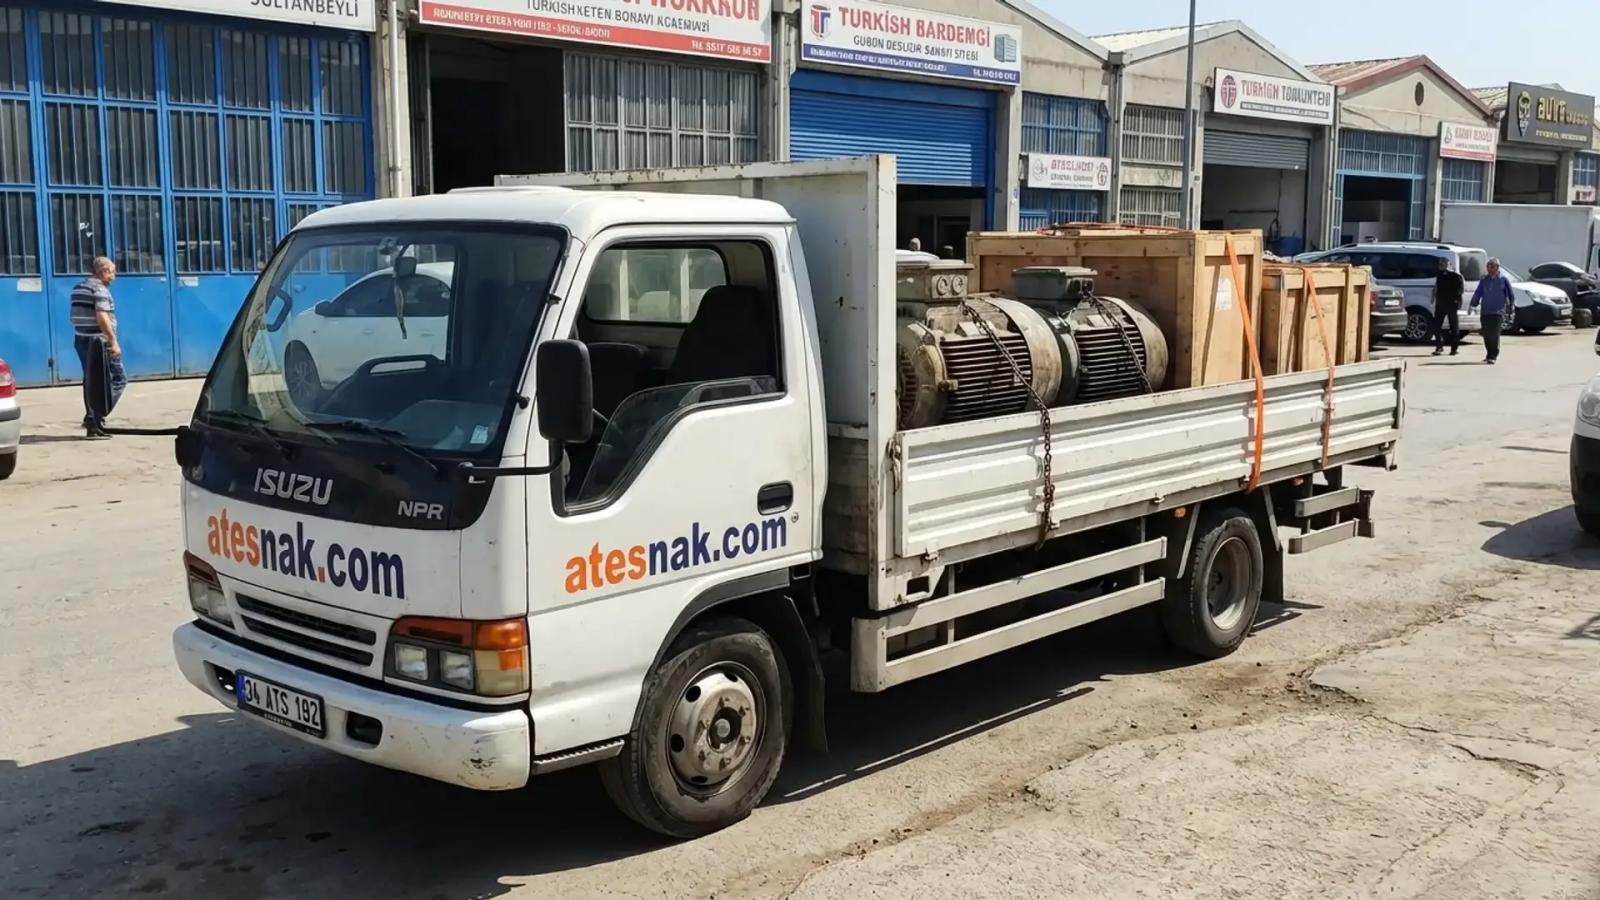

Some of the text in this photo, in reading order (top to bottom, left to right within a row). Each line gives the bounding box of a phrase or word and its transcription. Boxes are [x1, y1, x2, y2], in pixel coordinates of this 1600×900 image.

[254, 467, 334, 506] ISUZU
[397, 500, 444, 520] NPR
[207, 508, 405, 600] atesnak.com
[565, 515, 787, 594] atesnak.com
[245, 679, 260, 705] 34
[266, 685, 289, 716] ATS
[295, 696, 319, 727] 192
